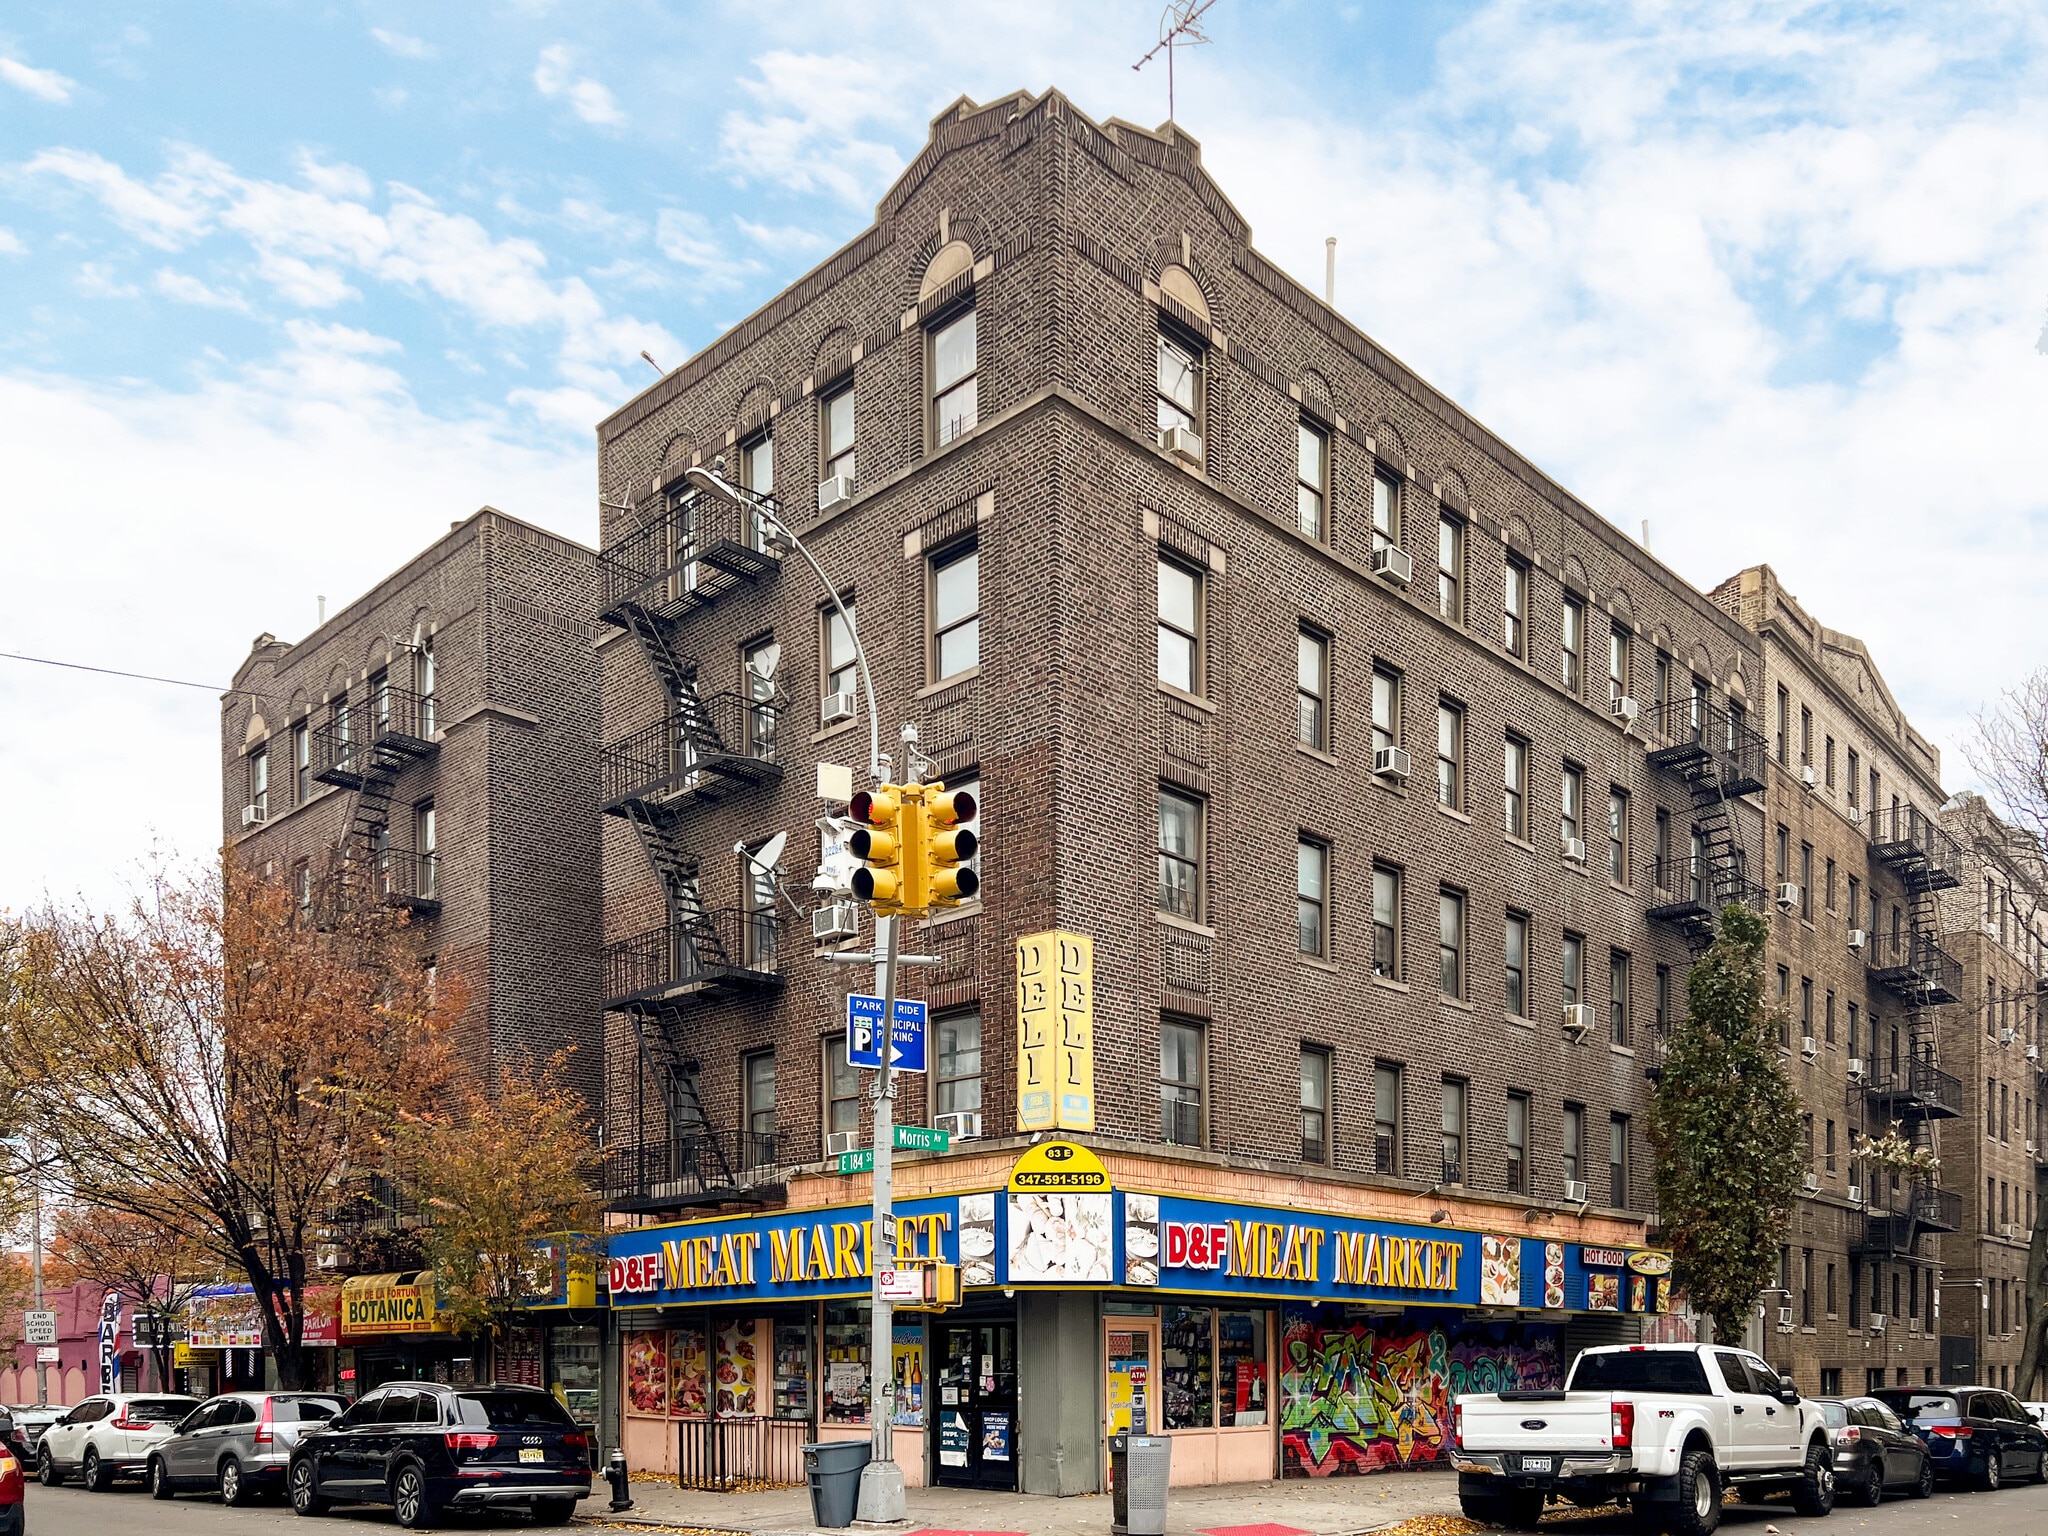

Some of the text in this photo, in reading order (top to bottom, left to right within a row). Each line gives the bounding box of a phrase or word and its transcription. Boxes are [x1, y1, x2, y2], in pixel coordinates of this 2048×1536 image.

[856, 1001, 919, 1015] PARK RIDE
[1020, 940, 1048, 1085] DELI
[1061, 939, 1089, 1085] DELI
[899, 1129, 942, 1147] Morris Av
[842, 1152, 872, 1170] E 184 St
[1048, 1149, 1071, 1158] 83 E
[1018, 1174, 1101, 1185] 347-591-5196
[610, 1254, 658, 1293] D&F
[662, 1232, 757, 1290] MEAT
[1168, 1220, 1463, 1291] D&F MEAT MARKET
[1585, 1249, 1622, 1264] HOT FOOD
[365, 1290, 374, 1299] DE
[376, 1289, 385, 1298] LA
[388, 1286, 421, 1298] FORTUNA
[350, 1298, 425, 1322] BOTANICA
[1131, 1371, 1146, 1379] ATM
